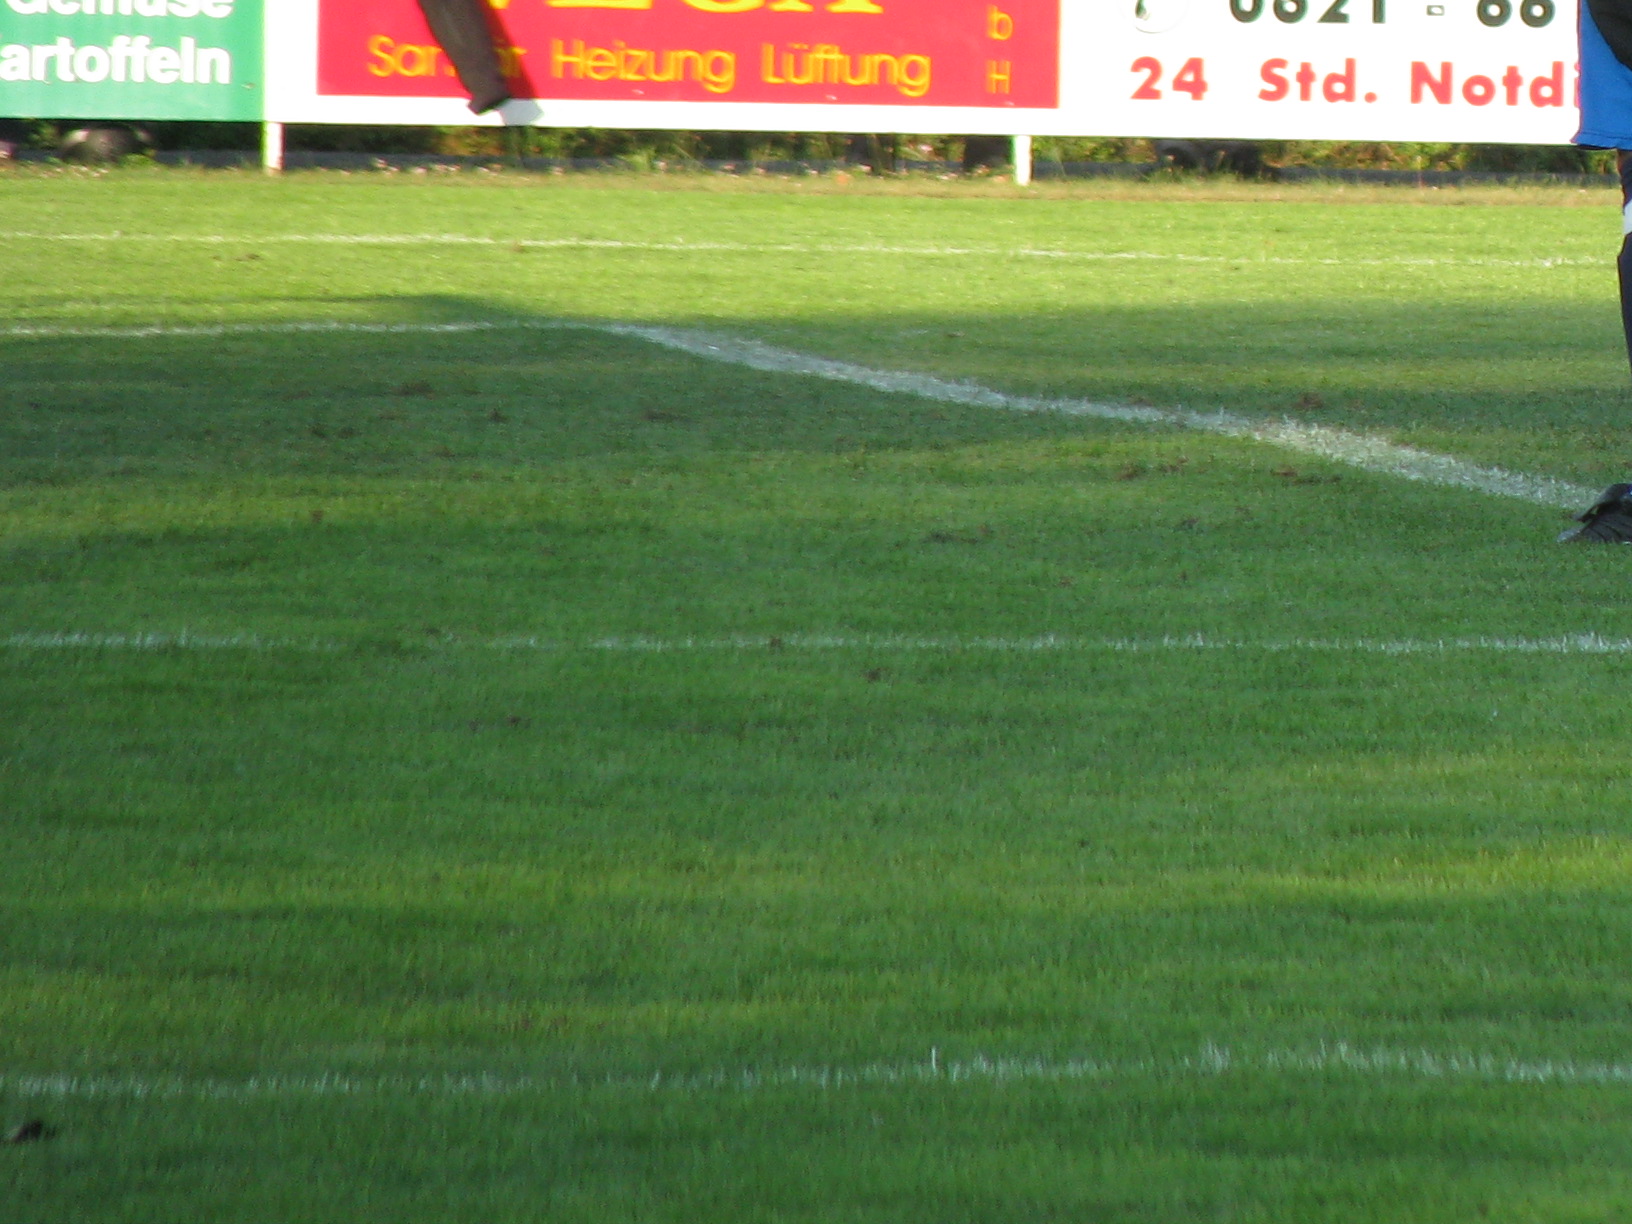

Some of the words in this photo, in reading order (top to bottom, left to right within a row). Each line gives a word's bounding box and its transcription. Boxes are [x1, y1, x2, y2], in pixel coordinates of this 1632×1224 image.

[551, 39, 737, 94] Heizung
[759, 42, 932, 98] Lüftung
[1129, 55, 1208, 102] 24
[1256, 57, 1378, 104] Std.
